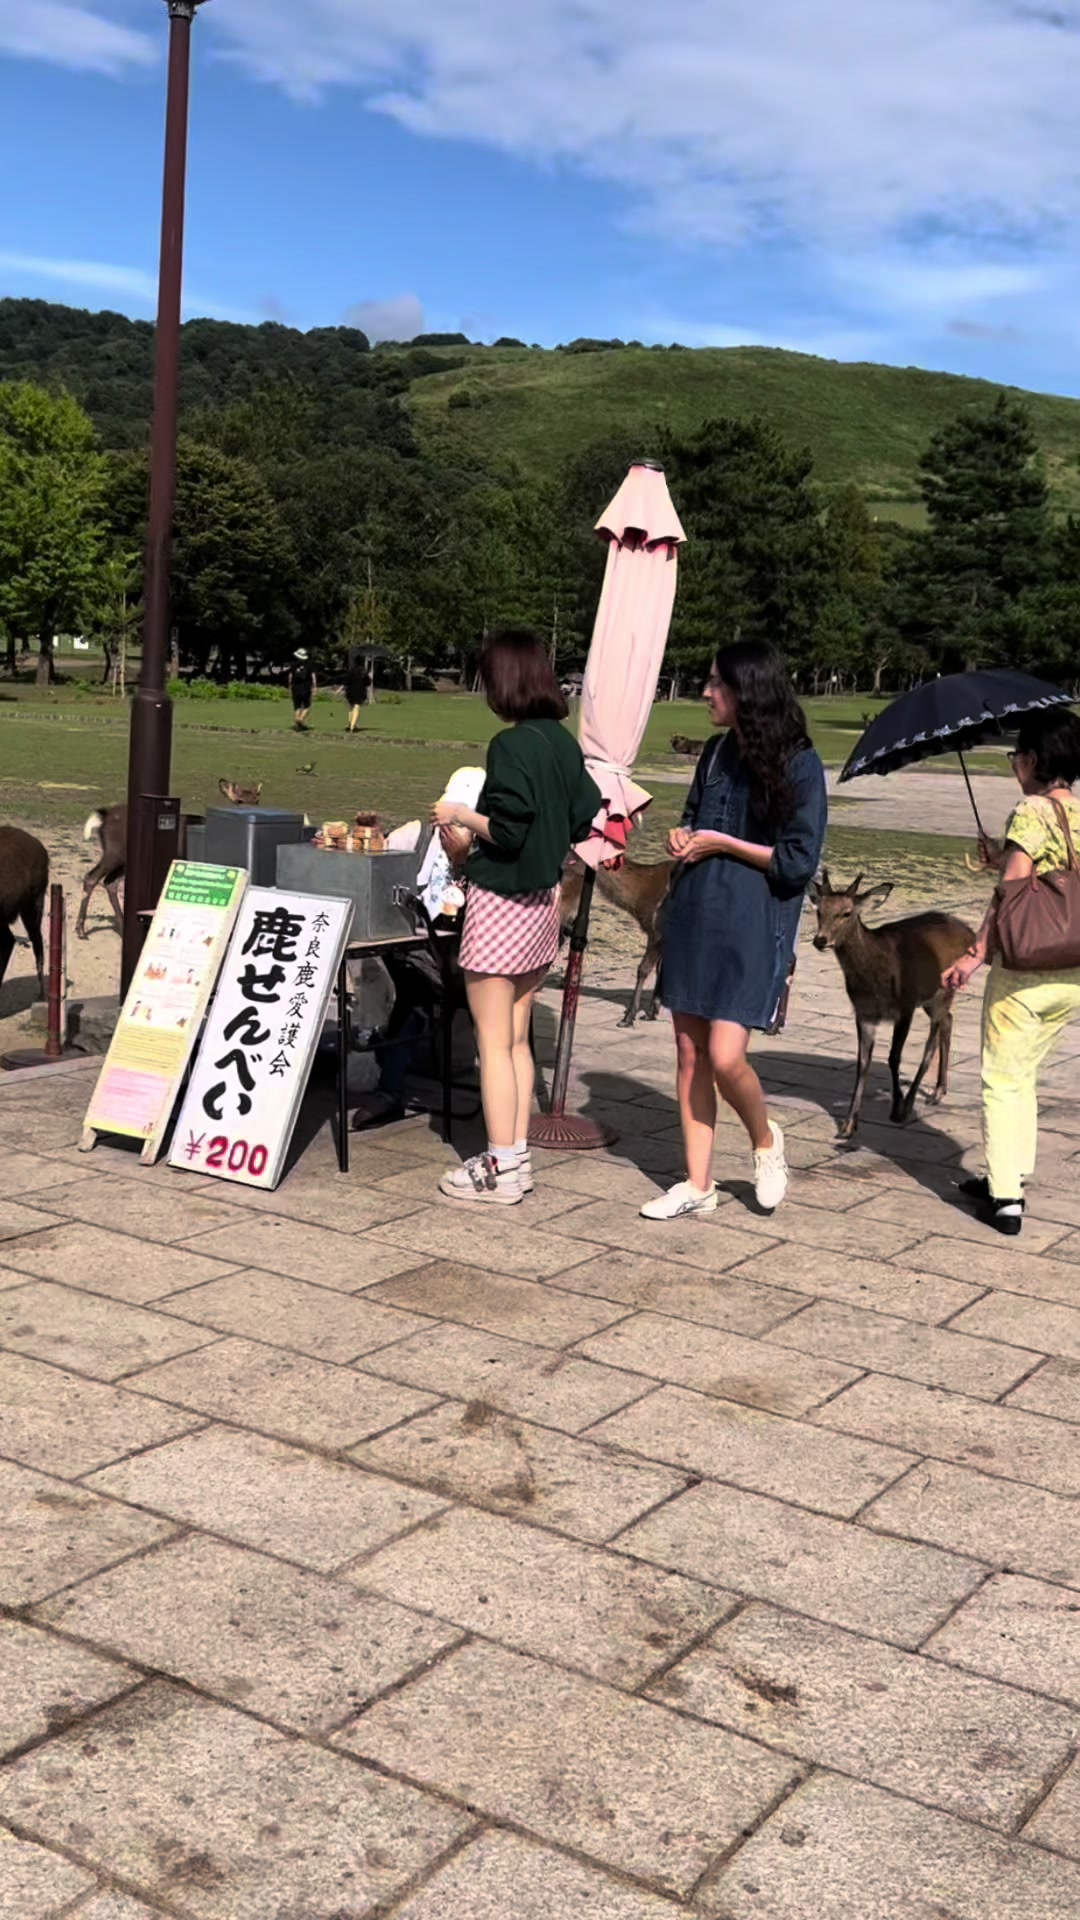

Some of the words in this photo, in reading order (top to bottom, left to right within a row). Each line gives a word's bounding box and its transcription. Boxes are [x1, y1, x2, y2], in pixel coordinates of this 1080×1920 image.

[202, 907, 306, 1121] 鹿せんべい
[269, 911, 330, 1077] 奈良鹿愛護会
[185, 1129, 269, 1177] ¥200
